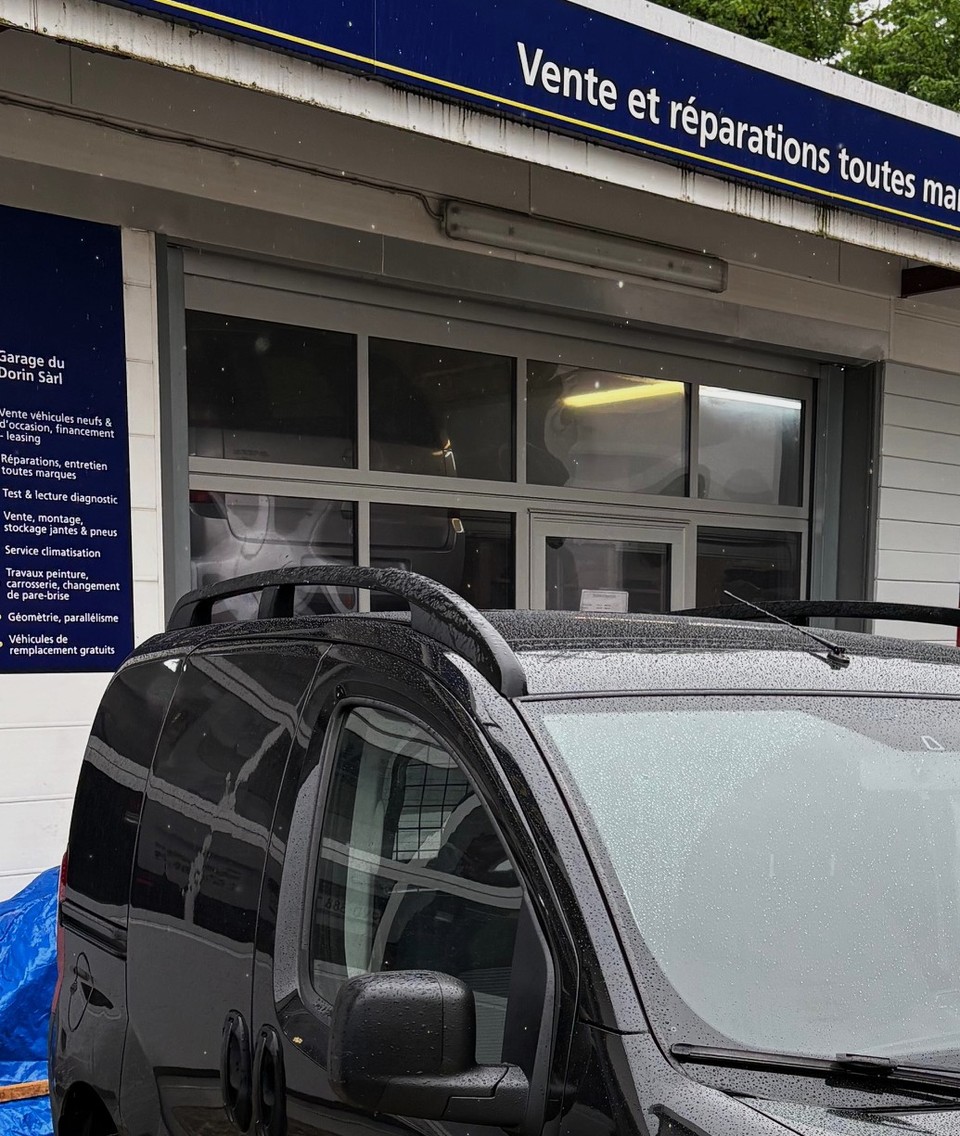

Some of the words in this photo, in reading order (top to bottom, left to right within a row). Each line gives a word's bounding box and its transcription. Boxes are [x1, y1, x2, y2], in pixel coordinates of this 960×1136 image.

[516, 41, 617, 111] Vente
[628, 87, 661, 125] et
[669, 95, 831, 174] réparations
[839, 147, 917, 199] toutes
[48, 356, 65, 369] du
[0, 366, 34, 381] Dorin
[38, 370, 63, 385] Sàrl
[0, 408, 28, 419] Vente
[30, 410, 74, 423] véhicules
[76, 416, 103, 427] neufs
[105, 417, 112, 428] &
[0, 419, 53, 434] d'occasion,
[55, 423, 115, 439] financement
[6, 431, 41, 446] leasing
[0, 453, 61, 469] Réparations,
[64, 460, 108, 471] entretien
[1, 466, 33, 477] toutes
[35, 470, 77, 481] marques
[2, 488, 22, 499] Test
[24, 489, 33, 499] &
[35, 490, 68, 502] lecture
[70, 492, 119, 505] diagnostic
[3, 511, 36, 523] Vente,
[38, 515, 84, 526] montage,
[3, 523, 47, 536] stockage
[49, 524, 78, 536] jantes
[80, 526, 88, 536] &
[89, 528, 118, 538] pneus
[4, 545, 39, 556] Service
[41, 546, 101, 558] climatisation
[5, 567, 44, 578] Travaux
[46, 569, 89, 581] peinture,
[6, 579, 60, 591] carrosserie,
[62, 580, 120, 593] changement
[6, 589, 20, 600] de
[22, 590, 70, 602] pare-brise
[64, 612, 119, 624] parallélisme
[8, 633, 54, 644] Véhicules
[55, 634, 68, 644] de
[9, 645, 78, 657] remplacement
[79, 645, 115, 657] gratuits
